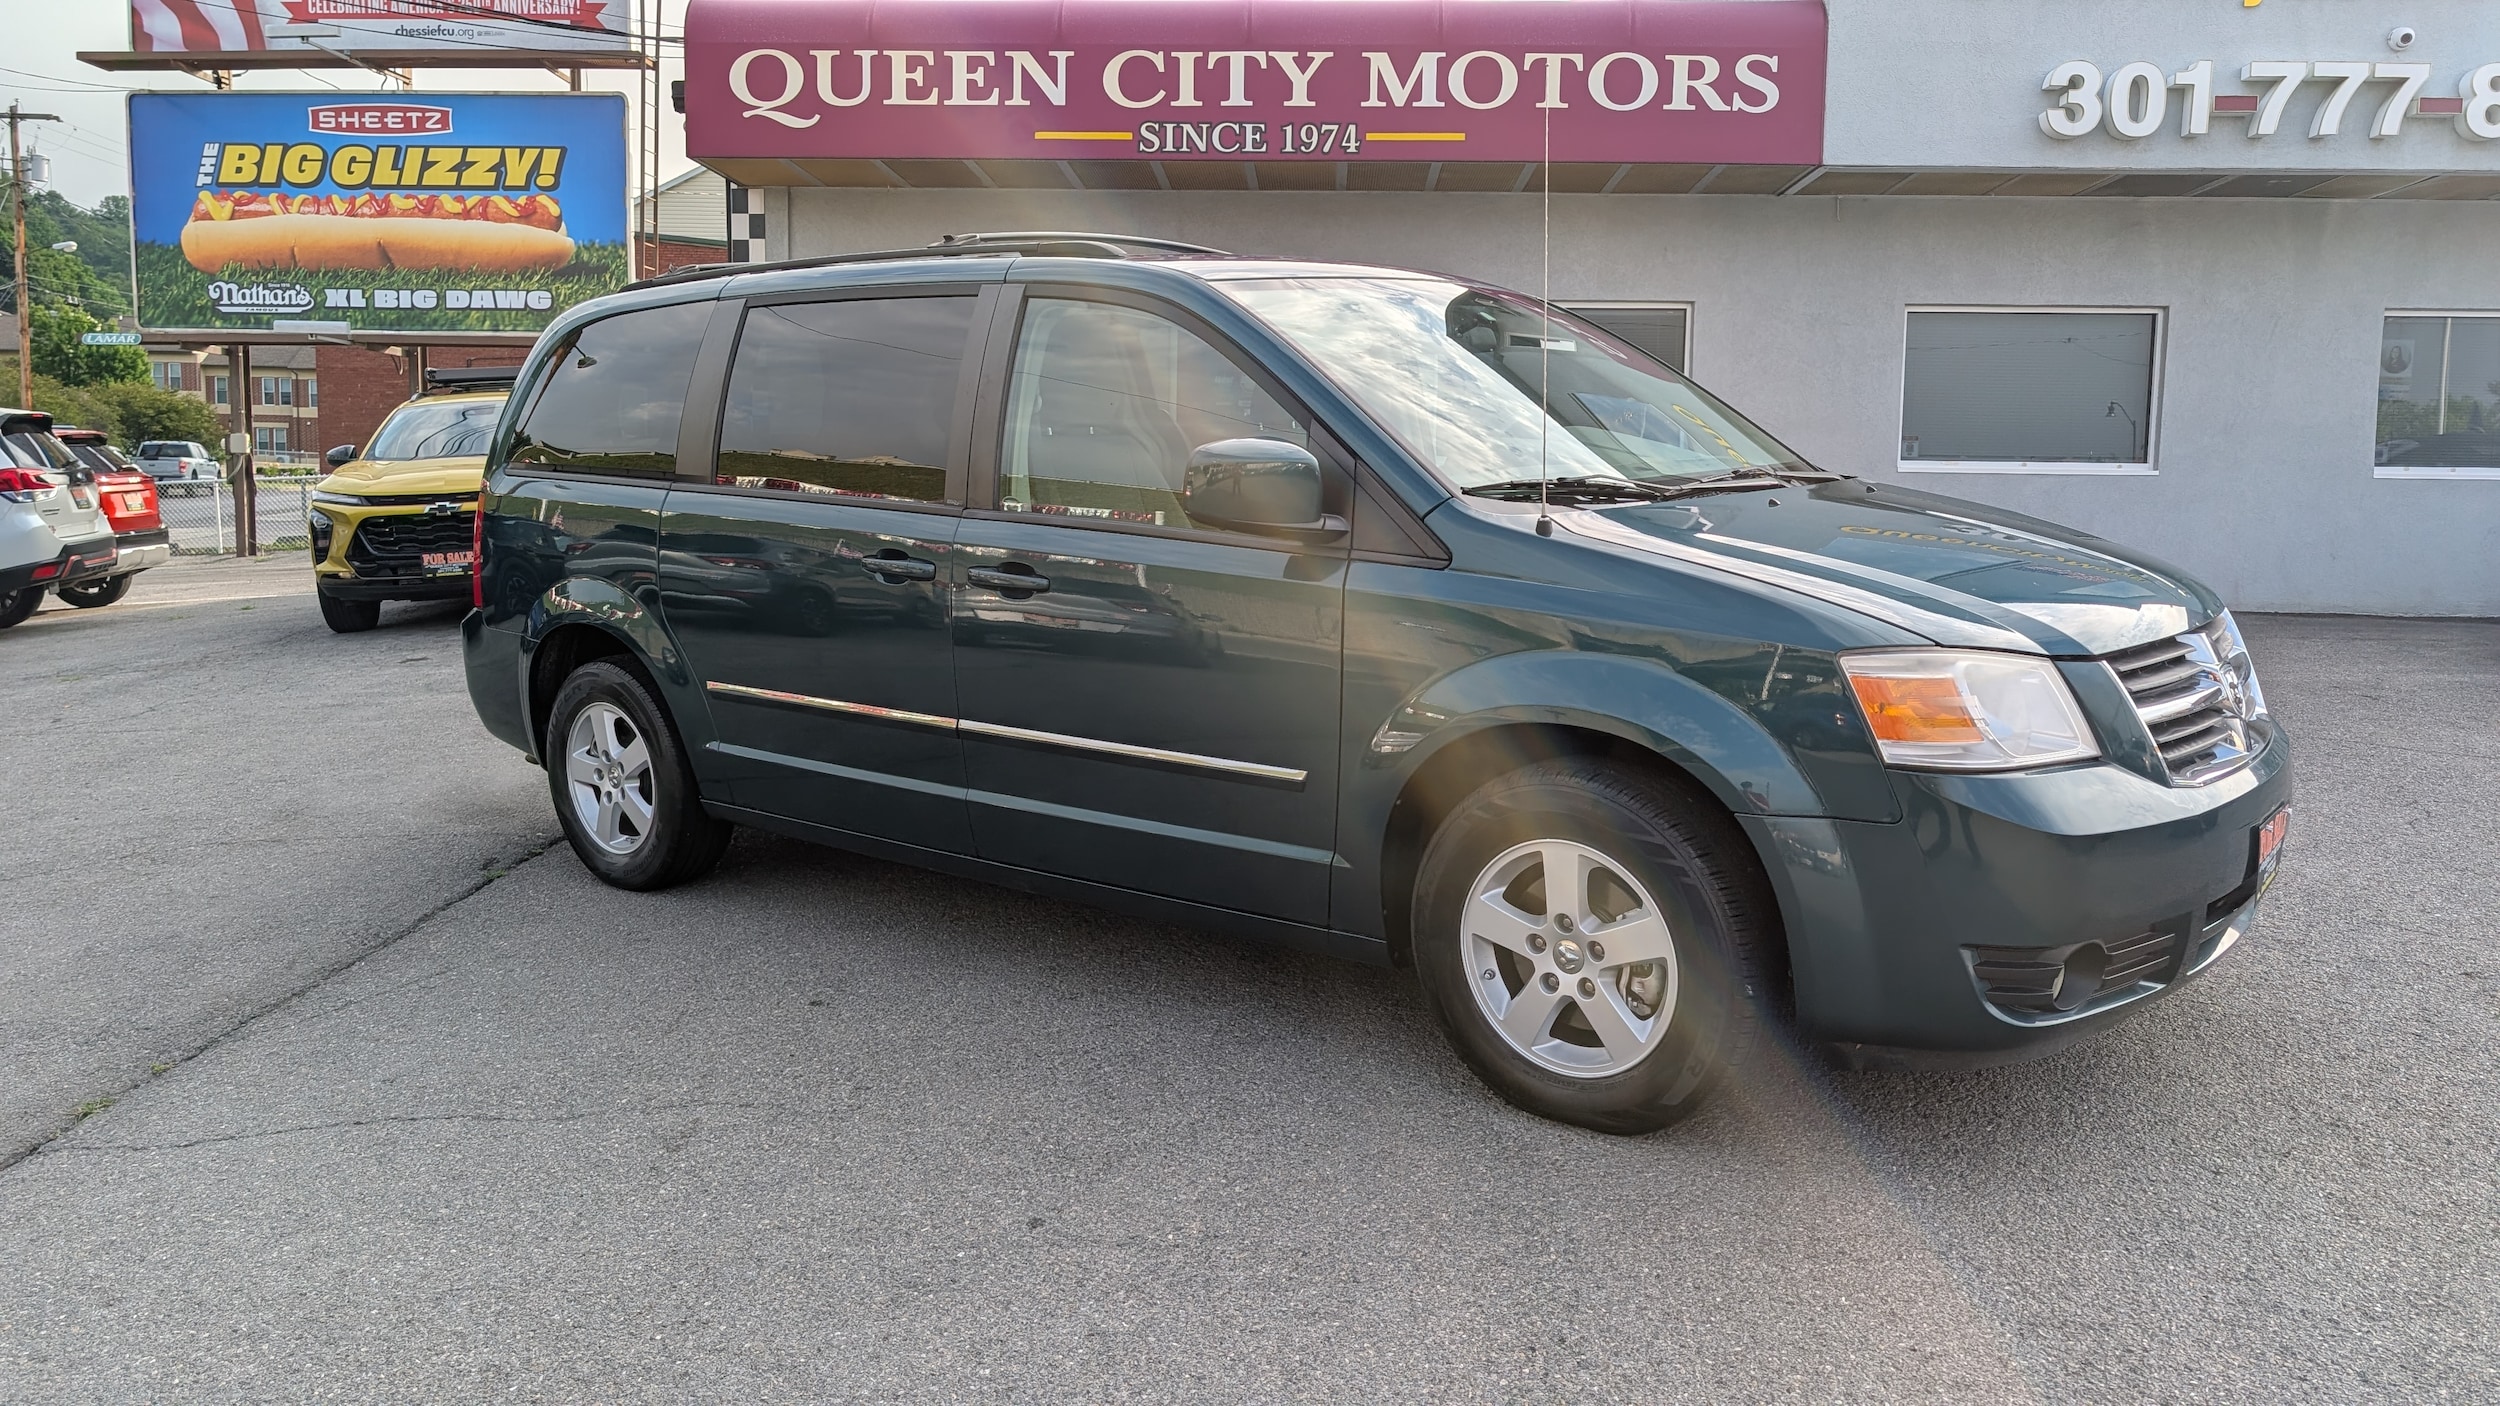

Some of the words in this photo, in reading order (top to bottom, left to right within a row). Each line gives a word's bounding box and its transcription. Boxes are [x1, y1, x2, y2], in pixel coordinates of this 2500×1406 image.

[308, 0, 388, 14] CELEBRATING
[494, 0, 581, 15] ANNIVERSARY!
[395, 24, 475, 40] chessiefcu.org
[728, 49, 1074, 128] QUEEN
[1102, 50, 1334, 108] CITY
[1361, 50, 1780, 114] MOTORS
[318, 111, 442, 129] SHEETZ
[1139, 121, 1267, 153] SINCE
[1281, 123, 1361, 153] 1974
[196, 142, 220, 187] THE
[217, 143, 325, 185] BIG
[330, 144, 562, 188] GLIZZY!
[207, 281, 314, 305] Nathan's
[324, 289, 367, 308] XL
[374, 289, 438, 309] BIG
[446, 290, 552, 309] DAWG
[87, 335, 136, 344] LAMAR
[422, 552, 446, 566] FOR
[446, 551, 474, 564] SALE
